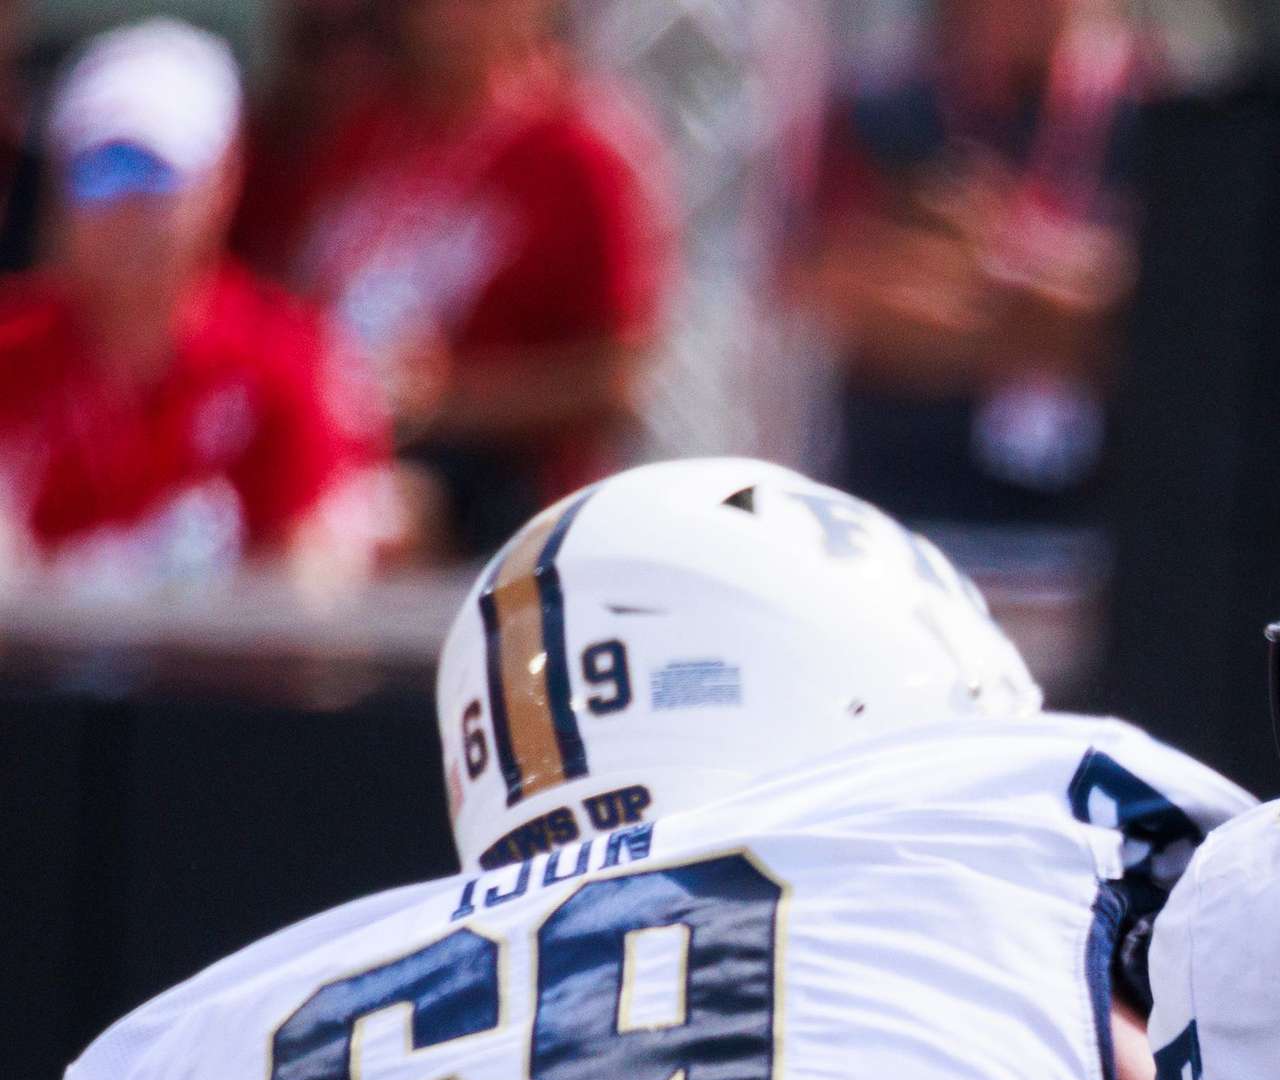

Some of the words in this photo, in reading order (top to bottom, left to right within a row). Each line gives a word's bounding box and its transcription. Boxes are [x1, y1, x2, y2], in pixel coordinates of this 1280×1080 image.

[461, 697, 489, 780] 6
[581, 638, 632, 717] 9
[582, 784, 653, 832] UP
